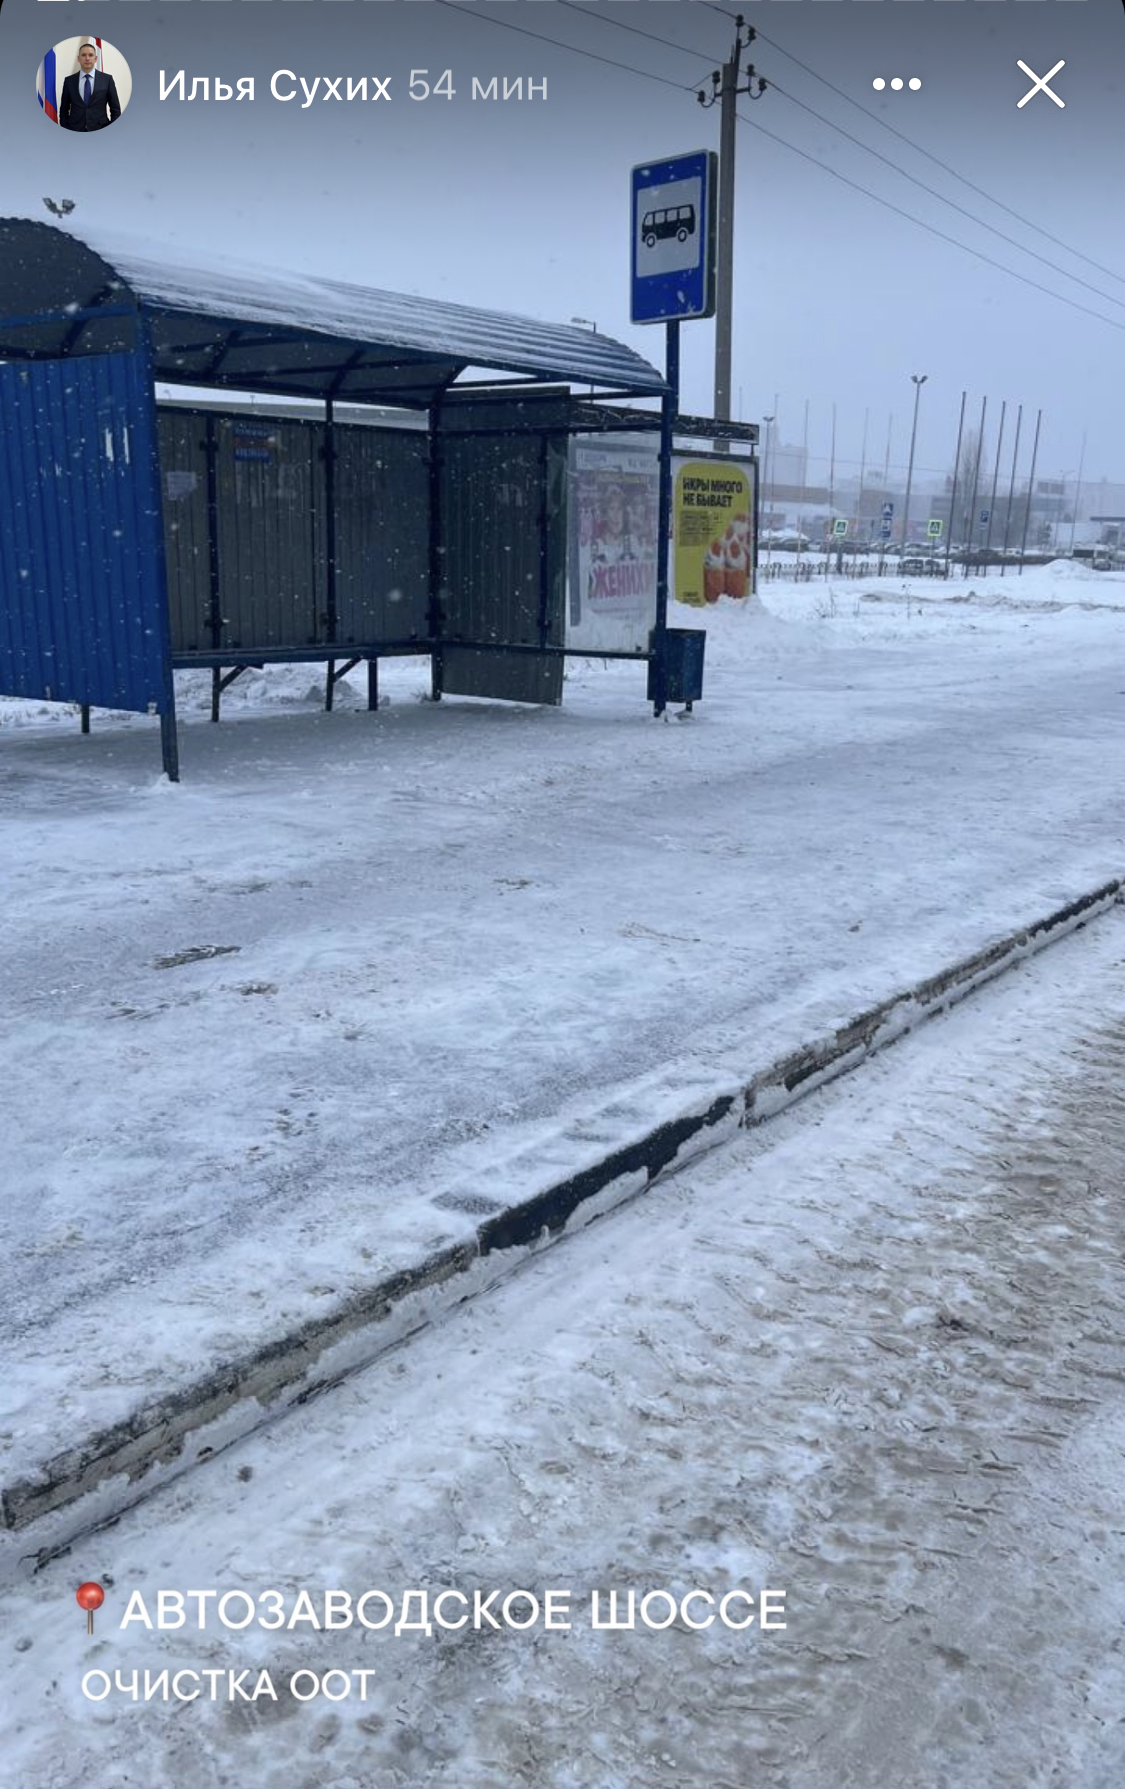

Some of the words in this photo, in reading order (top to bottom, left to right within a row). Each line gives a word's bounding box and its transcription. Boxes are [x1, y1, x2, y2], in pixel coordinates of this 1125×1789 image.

[682, 477, 710, 492] ИКРЫ
[710, 479, 743, 494] МНОГО
[682, 493, 695, 507] НЕ
[696, 493, 733, 508] БЫВАЕТ
